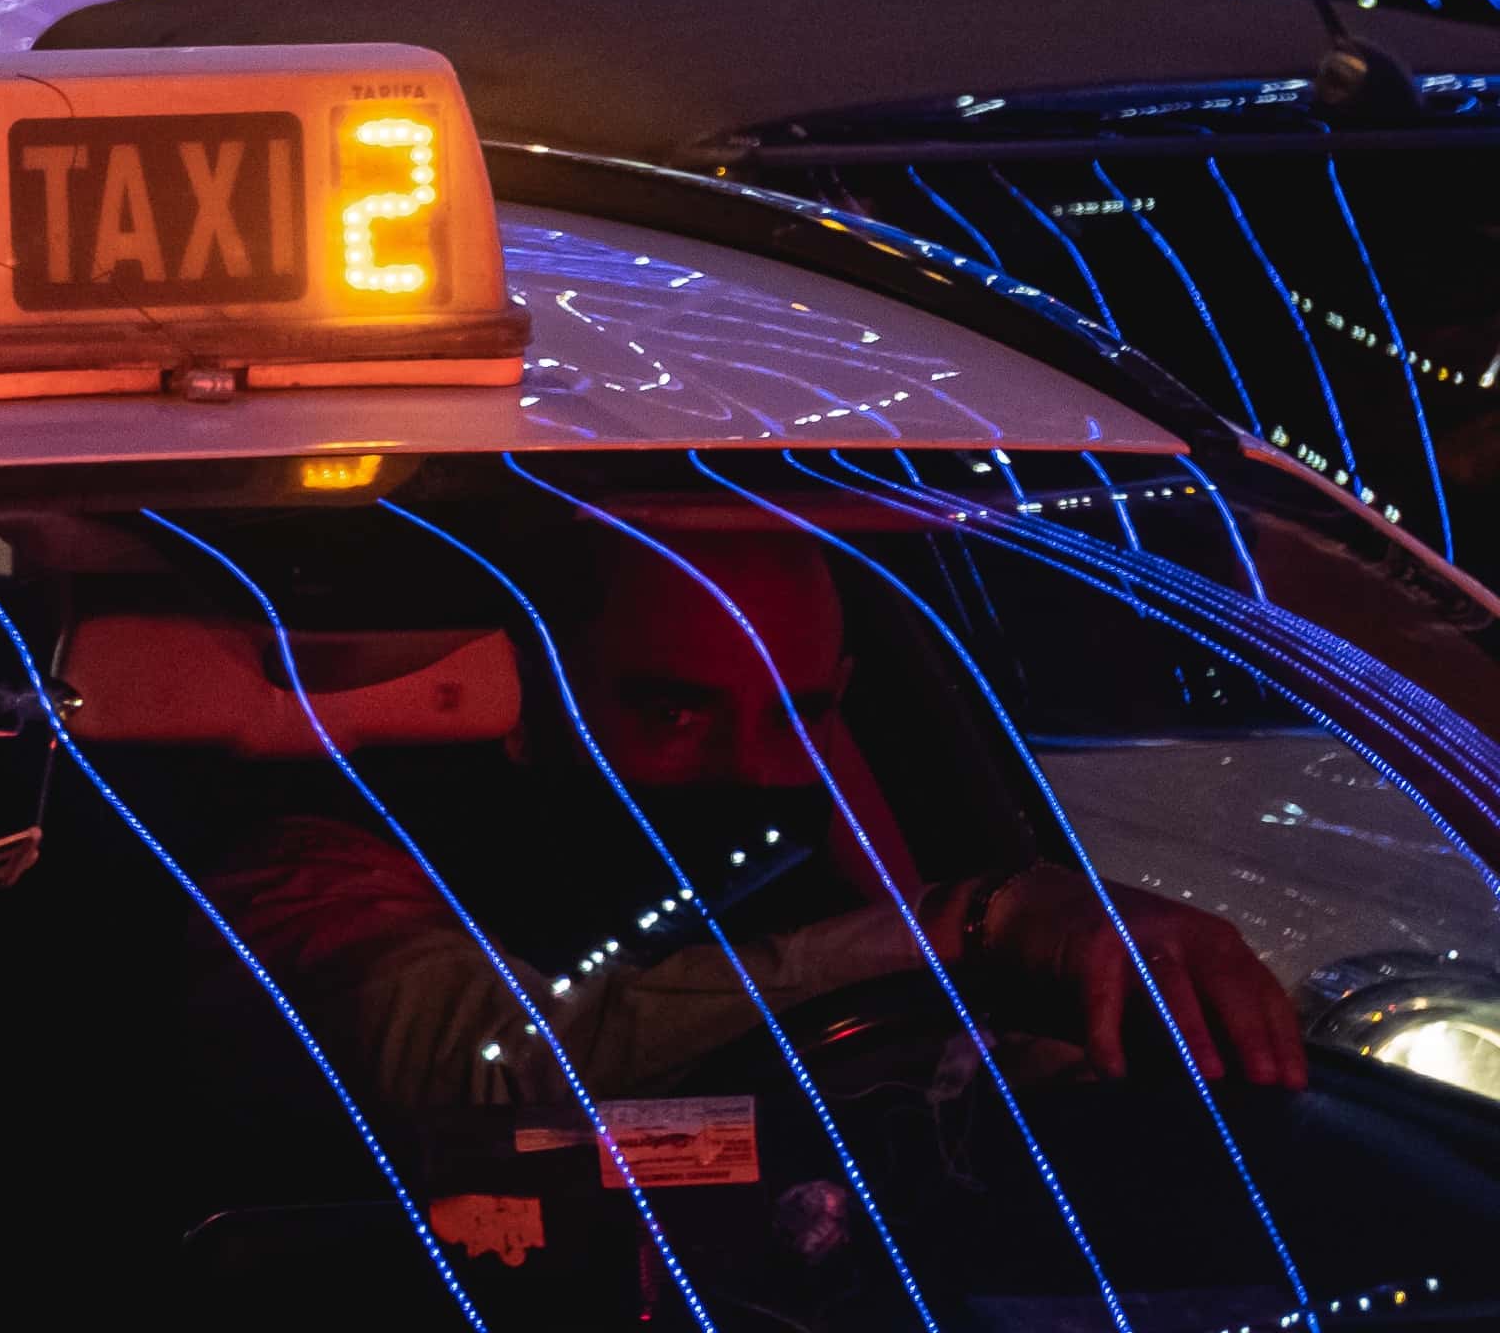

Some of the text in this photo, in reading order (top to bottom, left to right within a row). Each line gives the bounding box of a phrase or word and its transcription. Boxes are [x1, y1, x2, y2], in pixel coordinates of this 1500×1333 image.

[350, 84, 427, 100] TARIFA
[21, 117, 437, 294] TAXI 2
